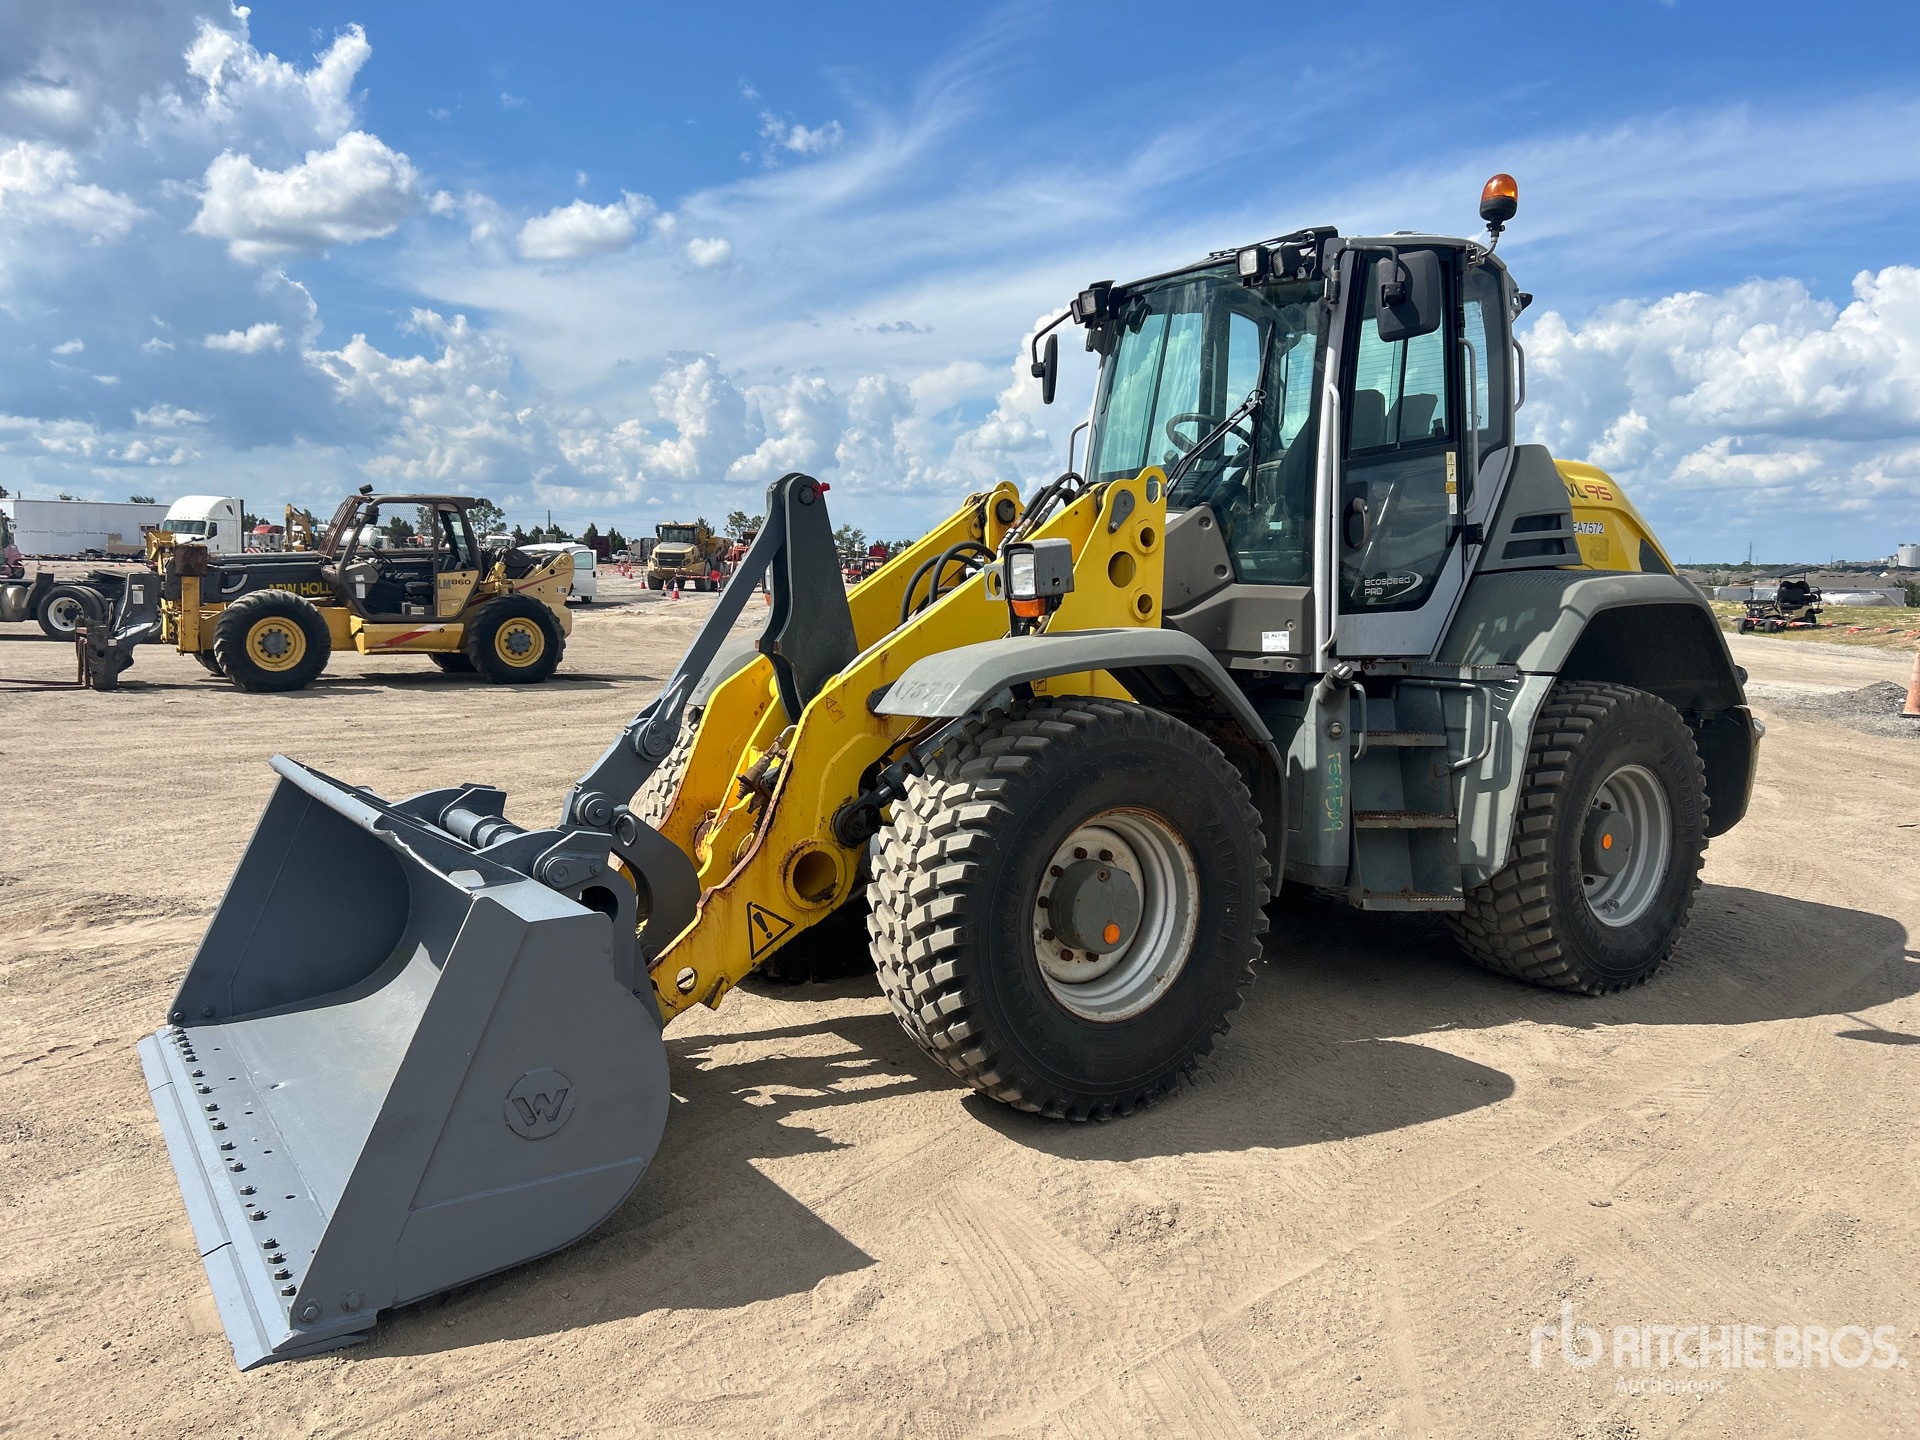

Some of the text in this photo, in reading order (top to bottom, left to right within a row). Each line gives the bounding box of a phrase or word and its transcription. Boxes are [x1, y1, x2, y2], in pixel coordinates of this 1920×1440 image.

[1364, 576, 1410, 587] ecospeed
[1364, 587, 1383, 596] PRO
[1201, 822, 1242, 957] ALLIANCE
